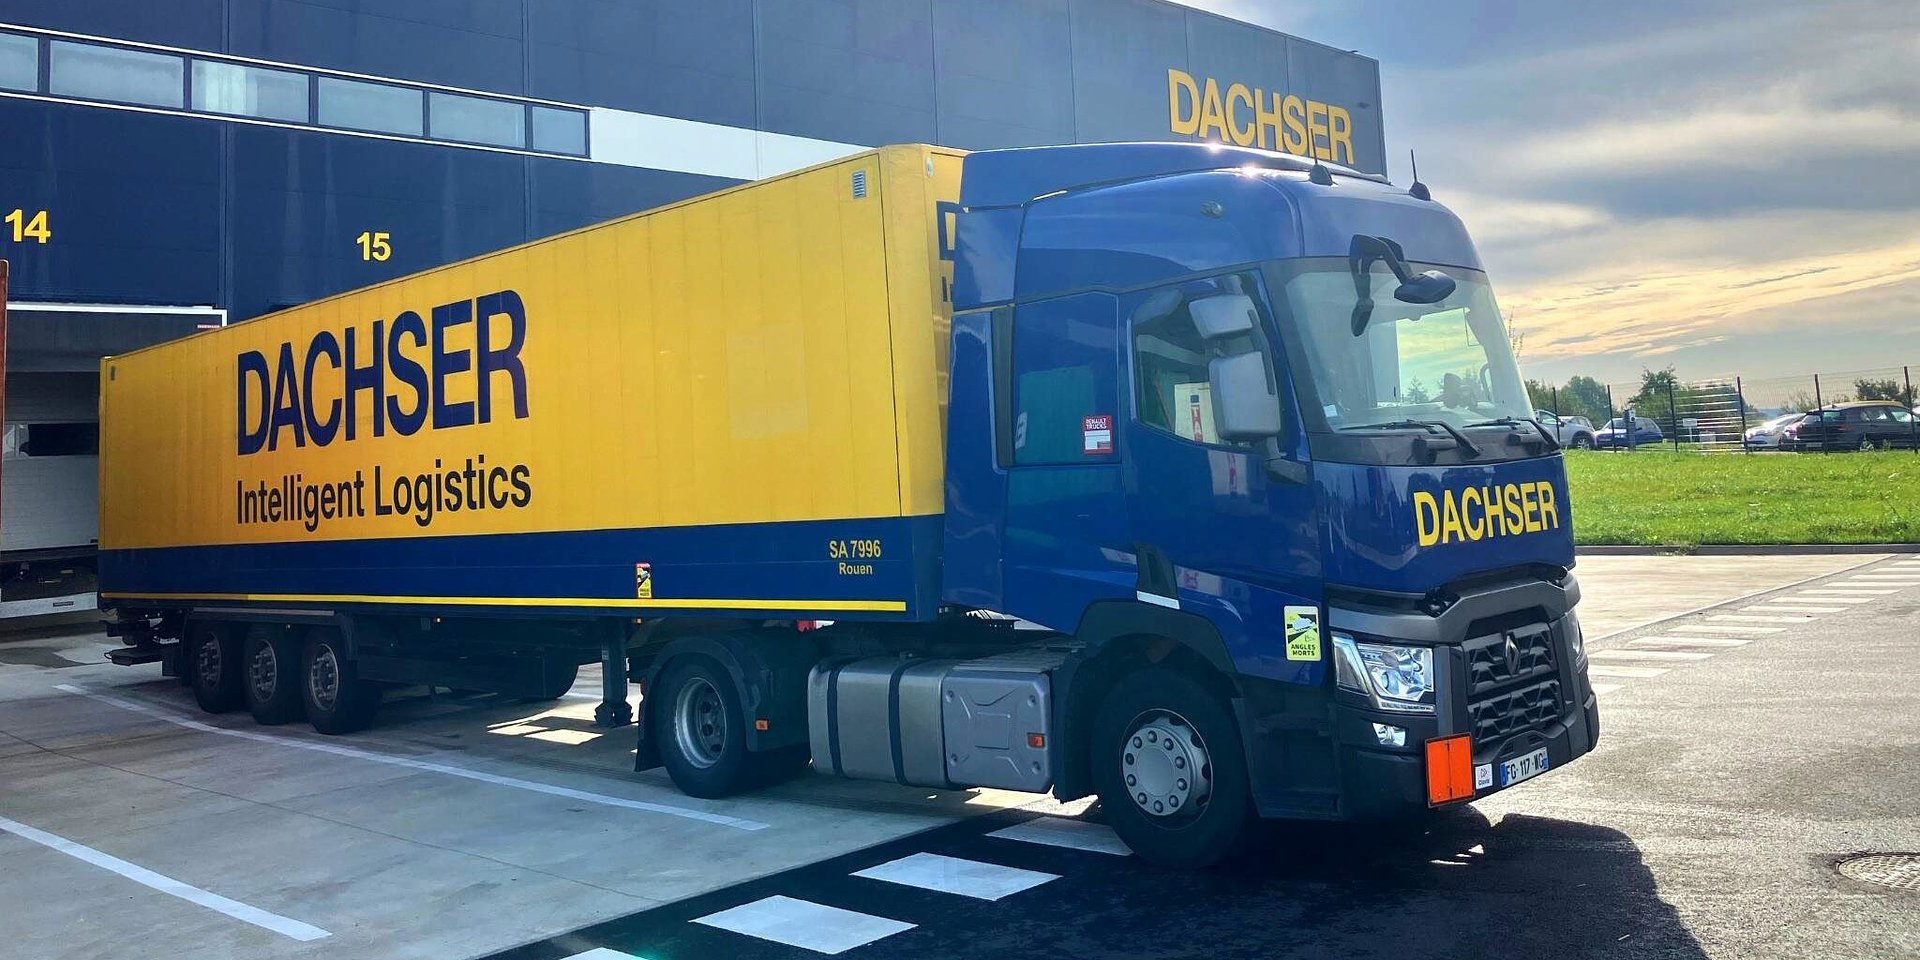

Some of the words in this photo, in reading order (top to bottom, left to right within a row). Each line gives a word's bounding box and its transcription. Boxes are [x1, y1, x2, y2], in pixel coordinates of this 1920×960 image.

[1167, 68, 1355, 165] DACHSER
[4, 208, 51, 244] 14
[356, 232, 391, 261] 15
[237, 289, 530, 456] DACHSER
[237, 471, 365, 532] Intelligent
[375, 454, 532, 527] Logistics
[1413, 481, 1559, 548] DACHSER
[829, 540, 848, 558] SA
[850, 539, 881, 558] 7996
[839, 562, 873, 575] Rouen
